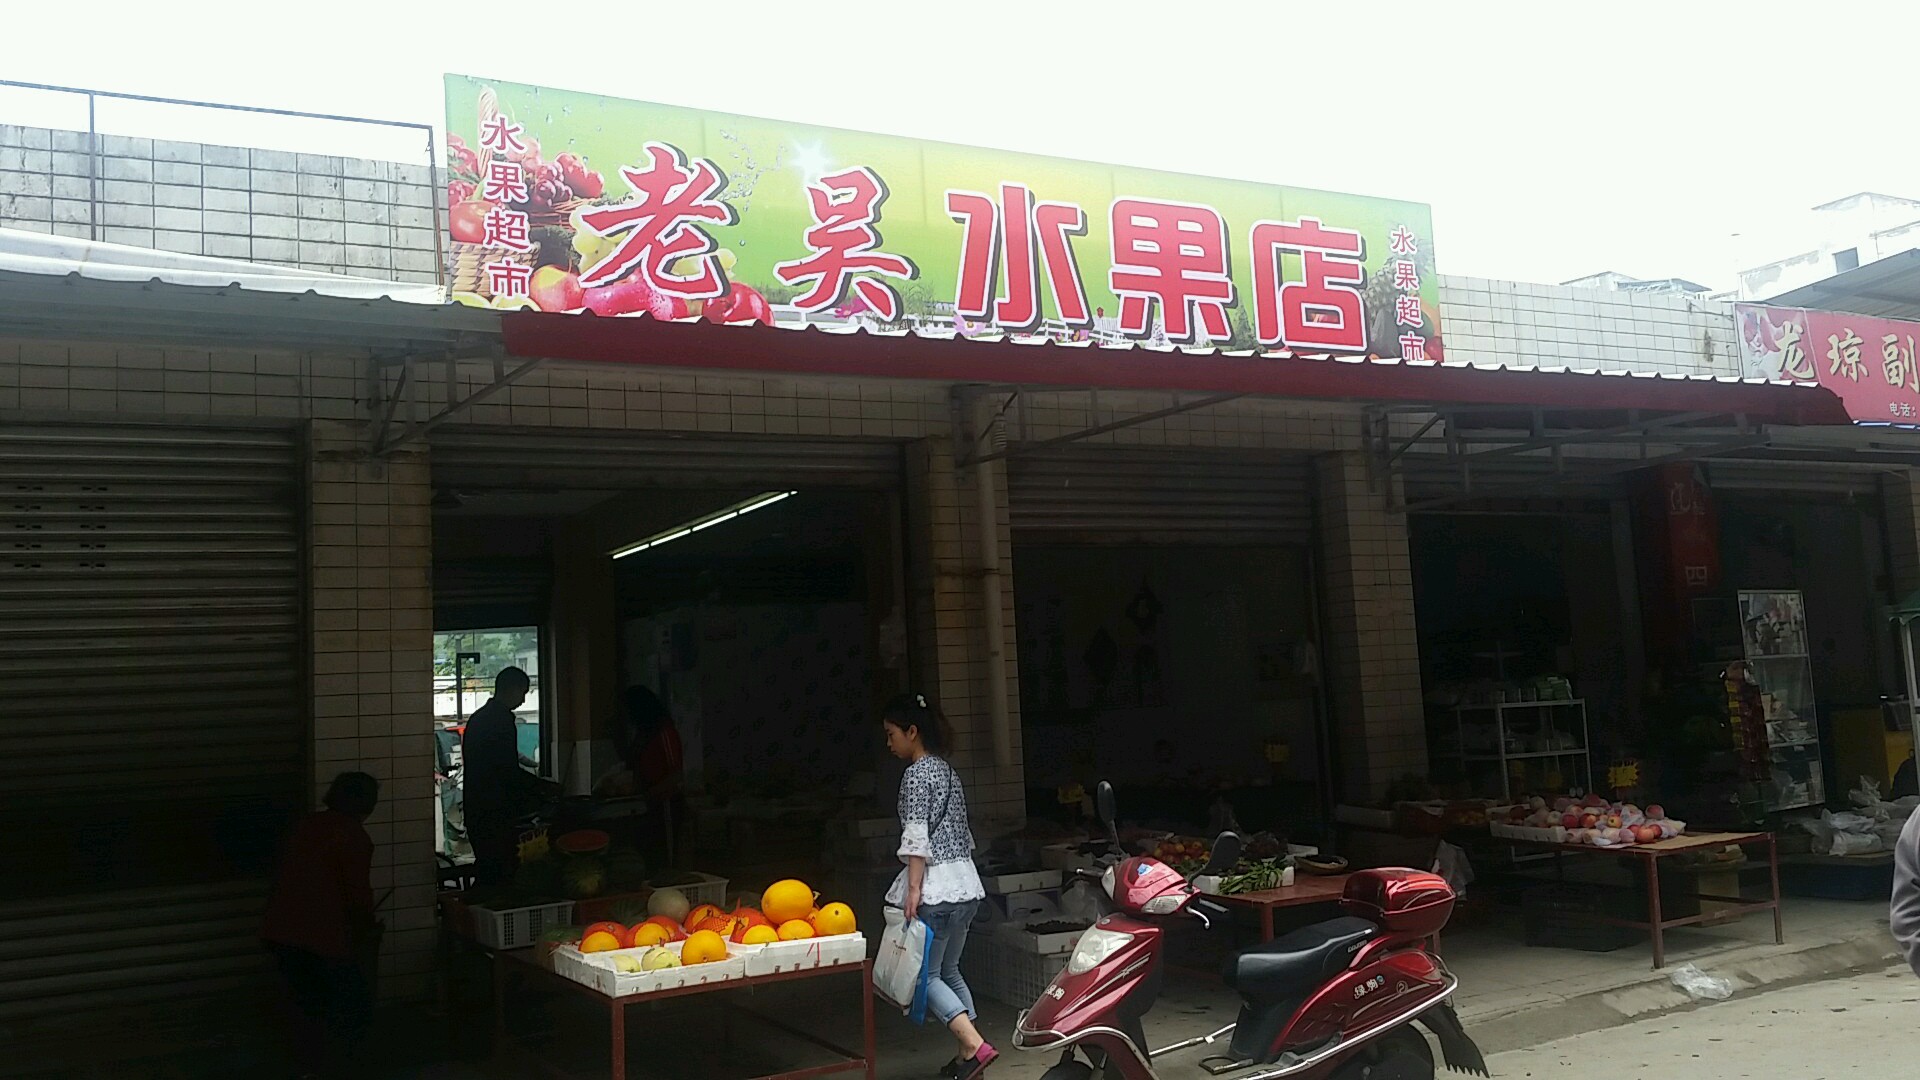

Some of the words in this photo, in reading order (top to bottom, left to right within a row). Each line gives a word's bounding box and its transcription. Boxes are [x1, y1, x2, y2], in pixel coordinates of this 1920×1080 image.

[481, 115, 533, 299] 水果超市
[581, 142, 1368, 351] 老吴水果店
[1391, 225, 1424, 361] 水果超市
